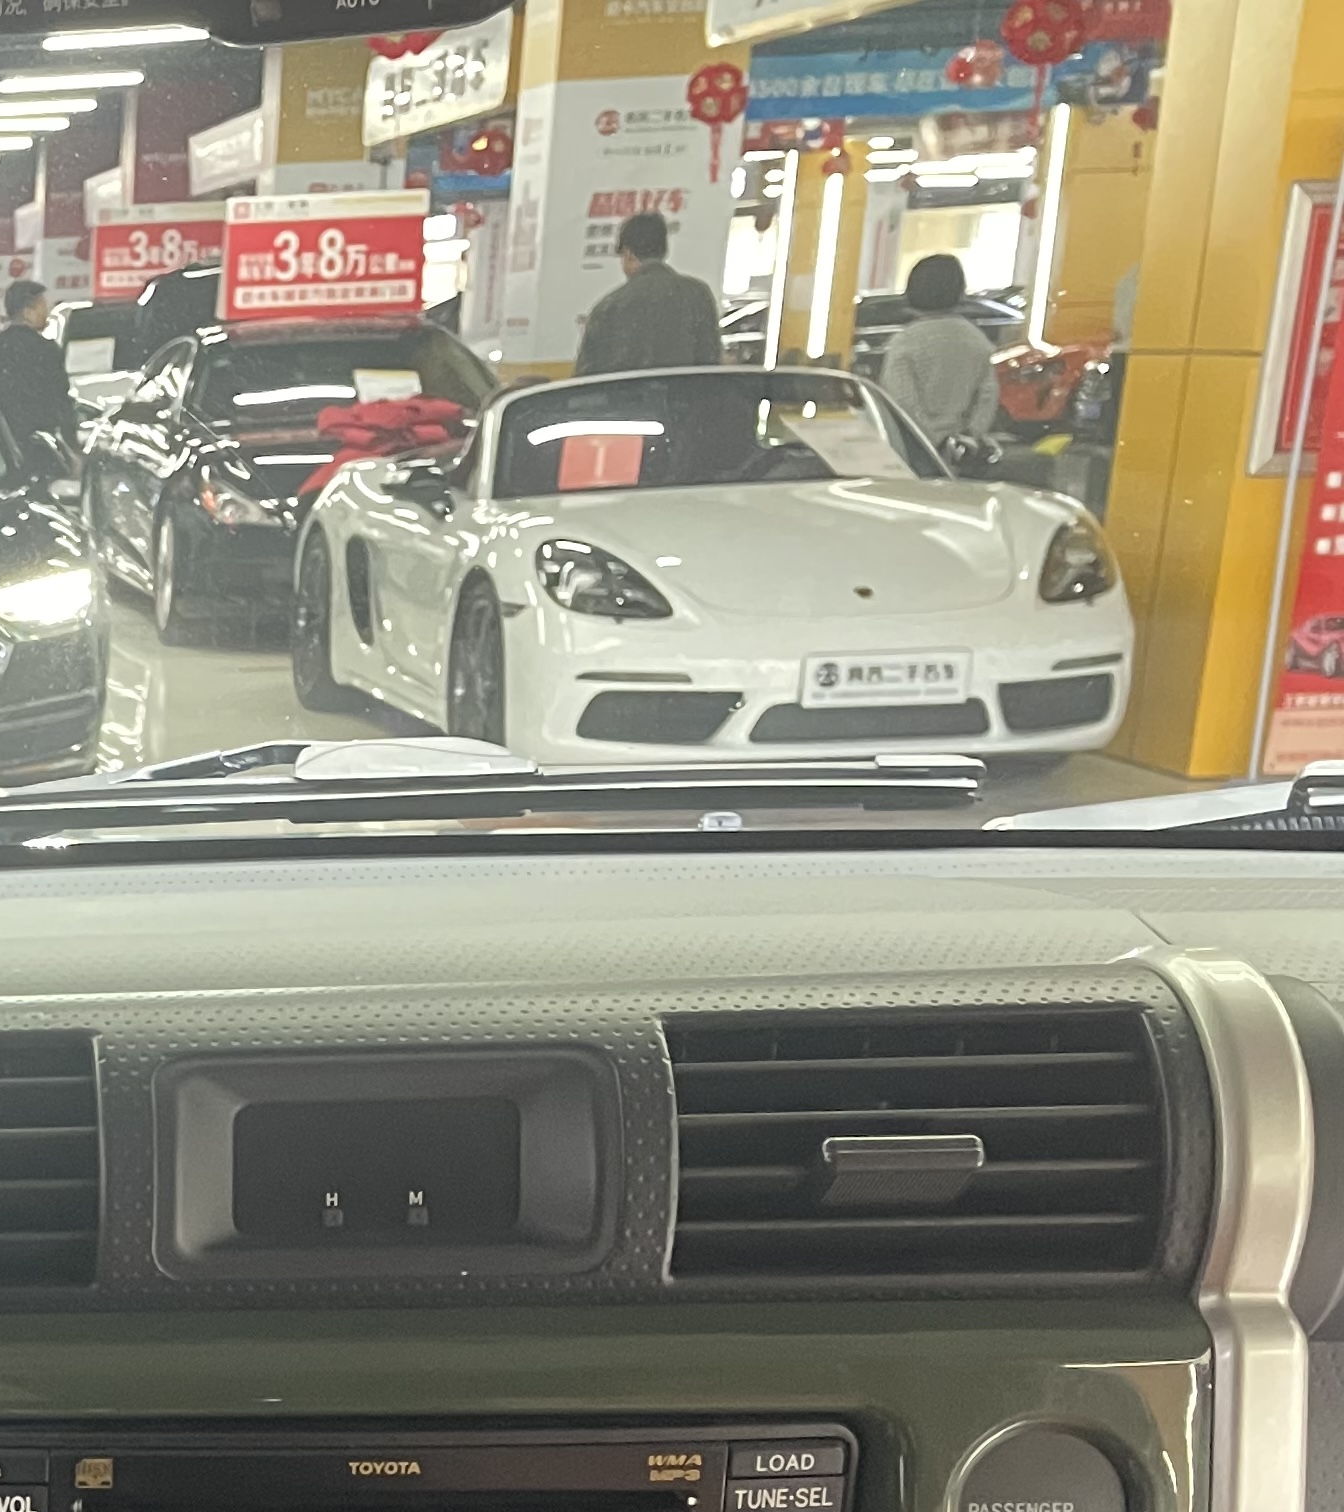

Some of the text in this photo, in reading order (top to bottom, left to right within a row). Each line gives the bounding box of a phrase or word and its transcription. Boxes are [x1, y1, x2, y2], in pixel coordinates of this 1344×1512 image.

[326, 1192, 339, 1207] H
[409, 1191, 423, 1206] M
[349, 1461, 421, 1475] TOYOTA
[648, 1454, 702, 1467] WMA
[756, 1453, 815, 1472] LOAD
